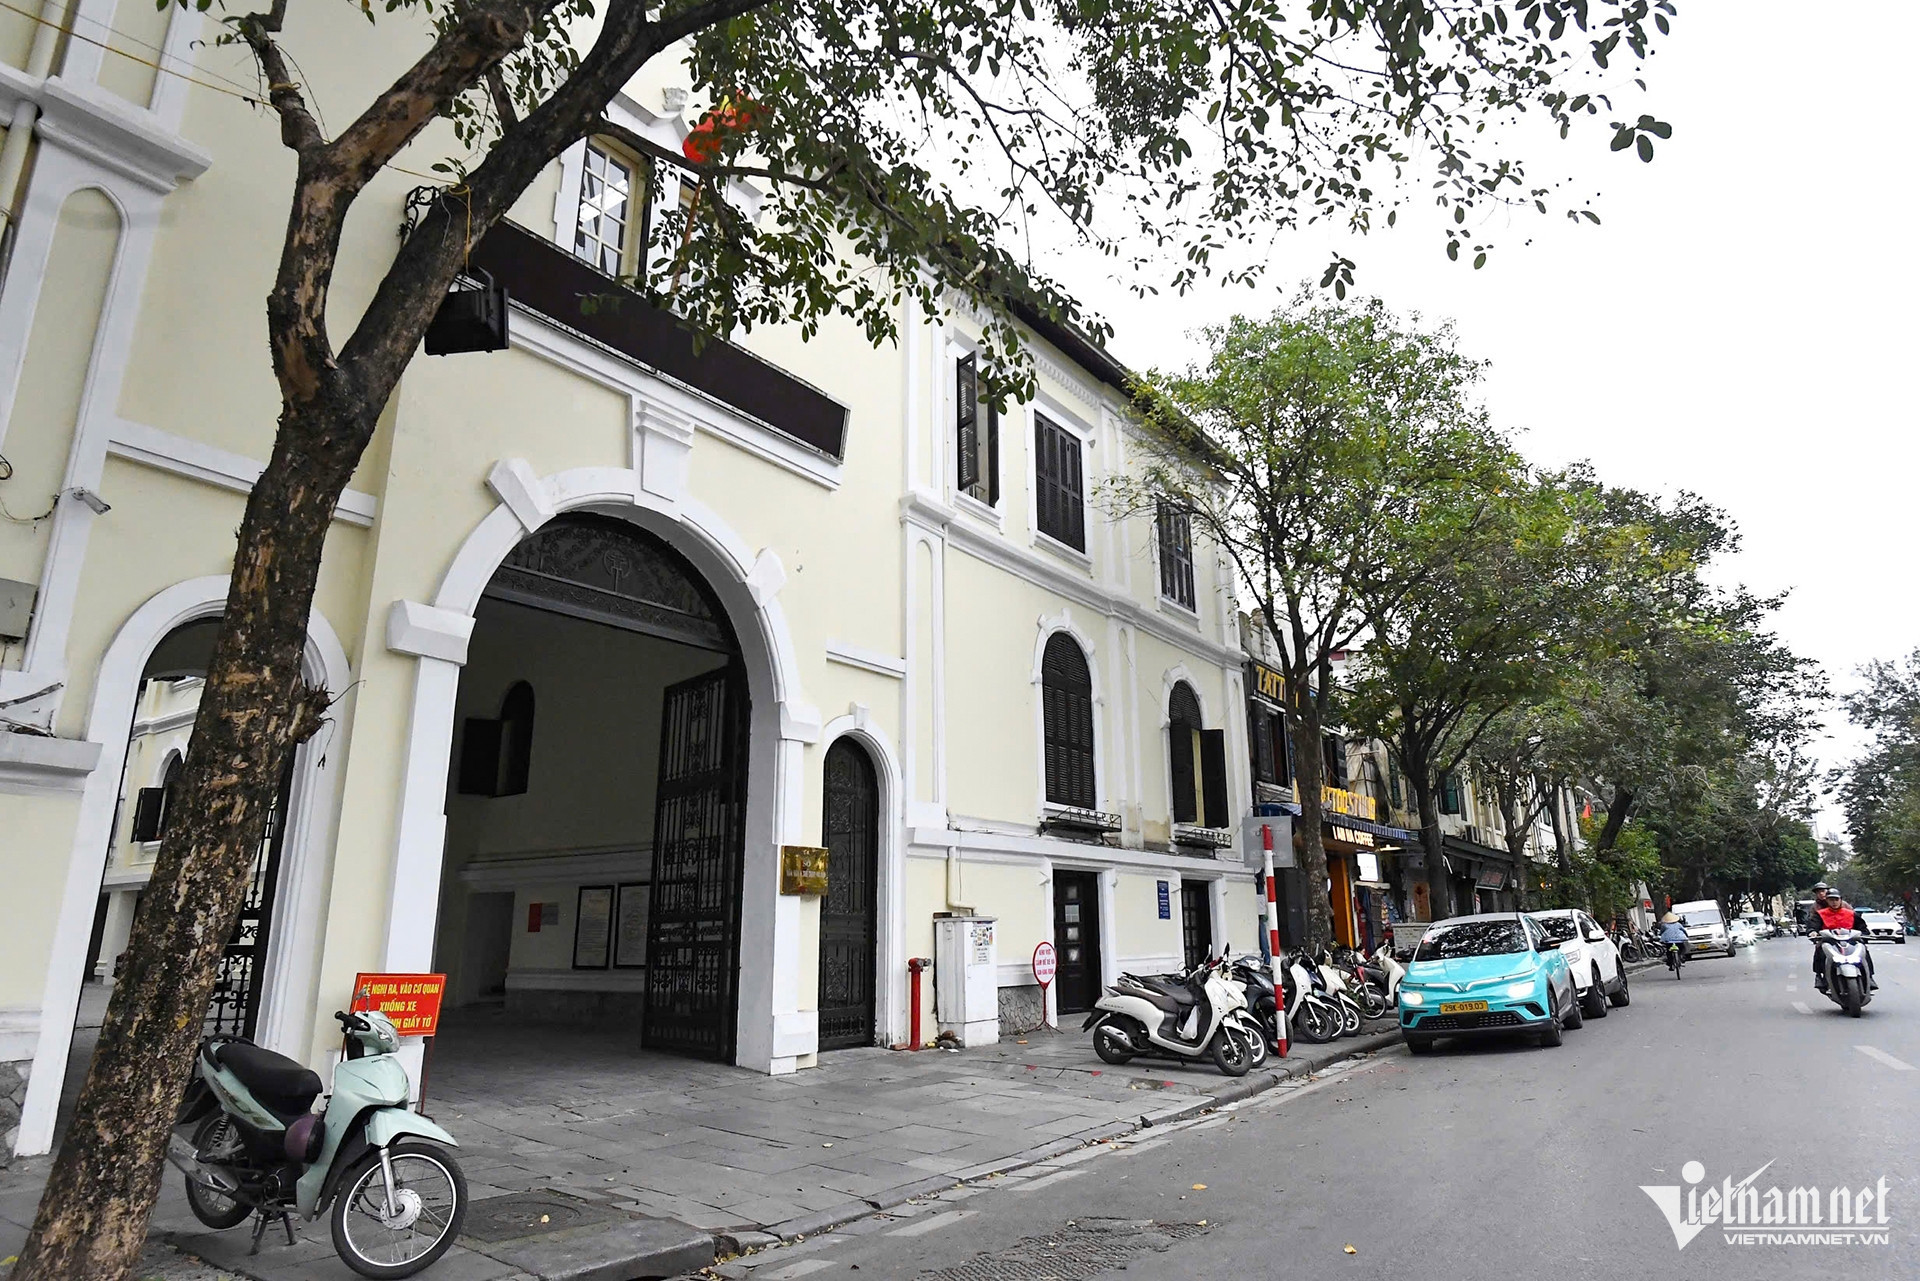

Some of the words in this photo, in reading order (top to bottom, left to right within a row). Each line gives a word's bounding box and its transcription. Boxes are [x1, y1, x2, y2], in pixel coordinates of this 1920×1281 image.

[1354, 830, 1375, 847] COFFEE
[422, 984, 440, 995] QUAN
[379, 998, 405, 1012] XUỐNG
[406, 1001, 417, 1011] XE
[402, 1014, 420, 1028] GIẤY
[422, 1014, 432, 1028] TỜ
